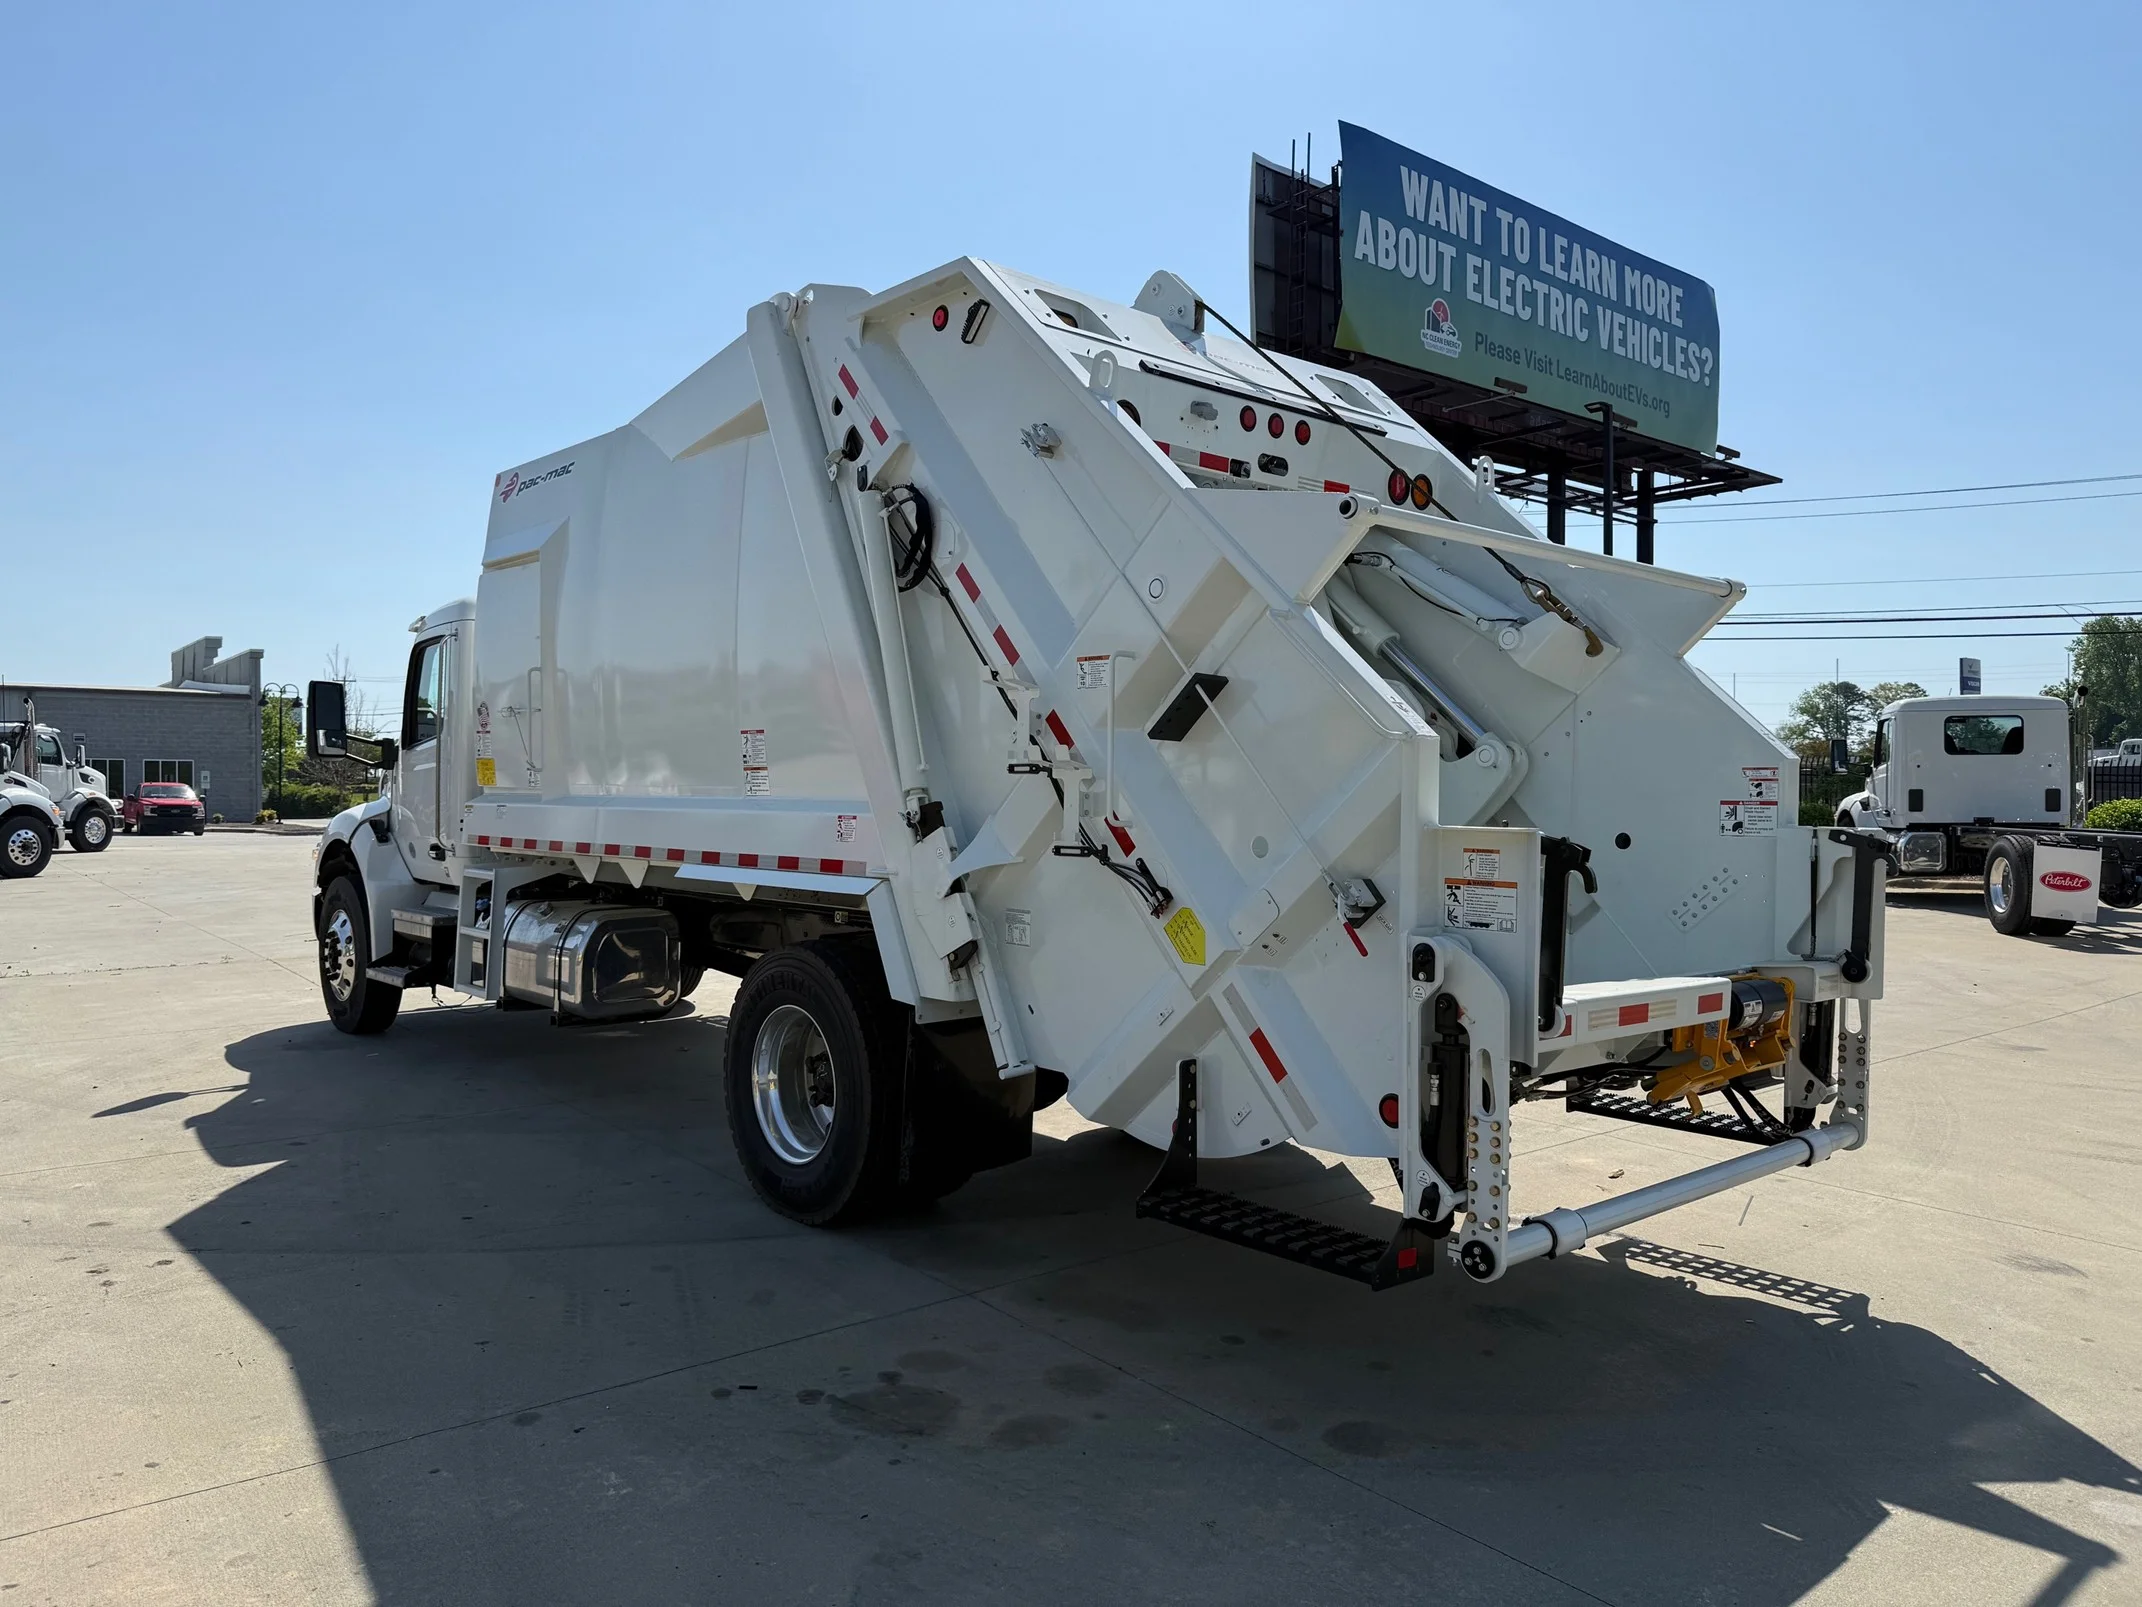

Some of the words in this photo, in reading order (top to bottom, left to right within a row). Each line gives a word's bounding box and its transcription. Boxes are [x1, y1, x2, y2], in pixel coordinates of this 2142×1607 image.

[1400, 165, 1487, 246] WANT
[1496, 207, 1530, 265] TO
[1539, 226, 1617, 302] LEARN
[1625, 264, 1683, 328] MORE
[1354, 209, 1457, 293] ABOUT
[1467, 252, 1589, 342] ELECTRIC
[1597, 305, 1714, 387] VEHICLES?
[1475, 331, 1521, 366] Please
[1524, 347, 1554, 377] Visit
[1556, 358, 1671, 419] LearnAboutEVs.org
[516, 461, 576, 497] pac-mac
[2045, 873, 2087, 888] Peterbilt
